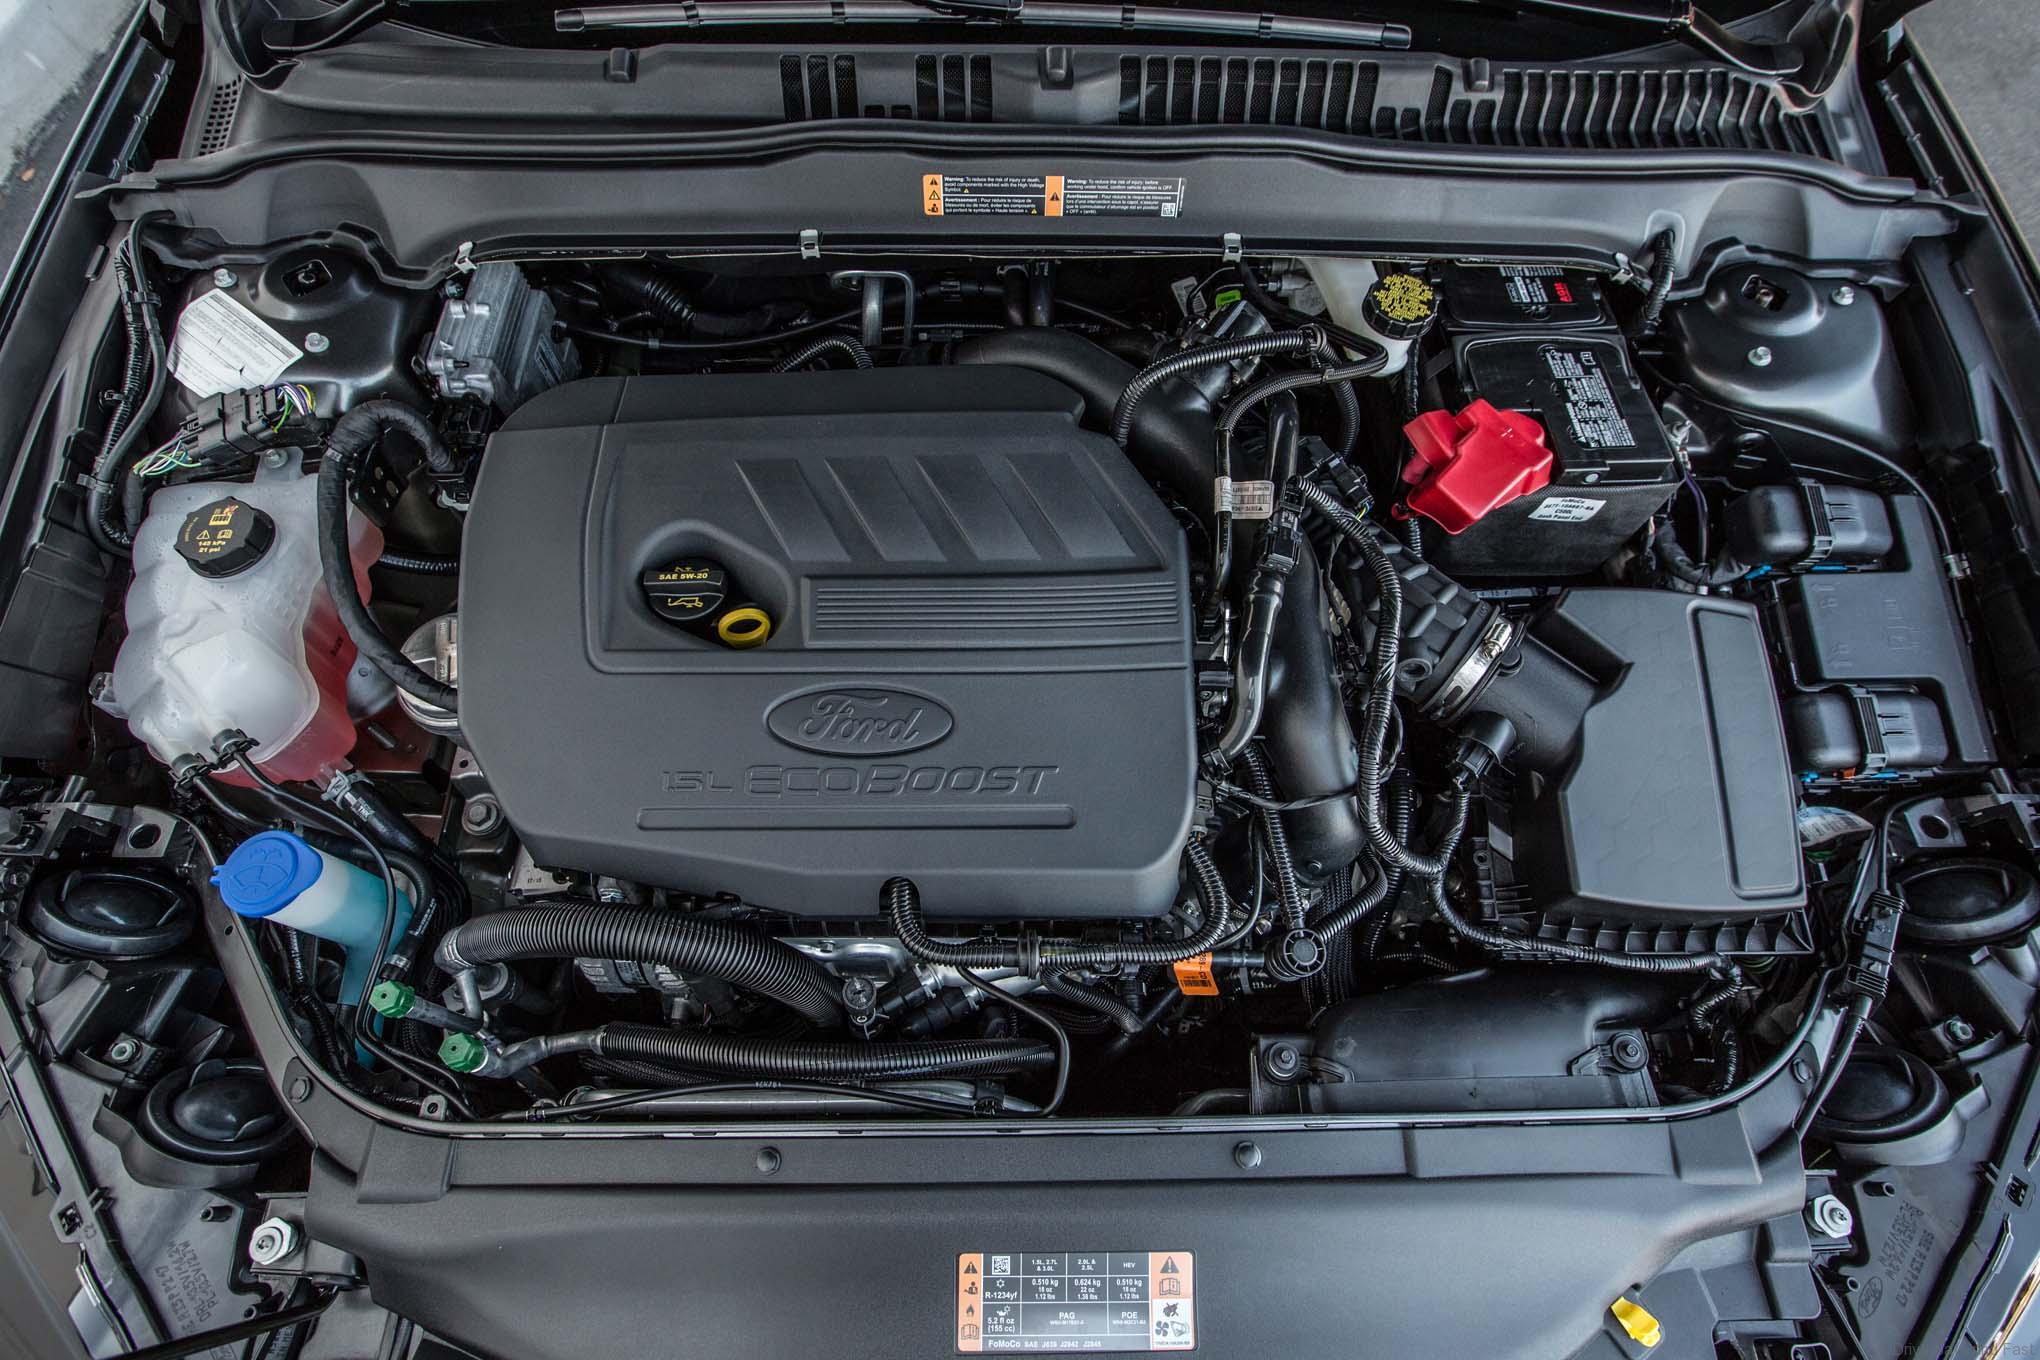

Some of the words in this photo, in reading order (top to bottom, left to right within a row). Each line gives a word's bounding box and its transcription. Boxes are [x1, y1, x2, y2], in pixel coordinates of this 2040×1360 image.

[1554, 282, 1570, 302] AGM
[803, 692, 923, 745] Ford
[1050, 1279, 1059, 1287] kg
[1093, 1279, 1101, 1287] kg
[1134, 1279, 1142, 1287] kg
[985, 1292, 1018, 1301] R-1234yf
[1059, 1312, 1076, 1320] PAG
[988, 1325, 1004, 1334] (155
[1004, 1325, 1016, 1334] cc)
